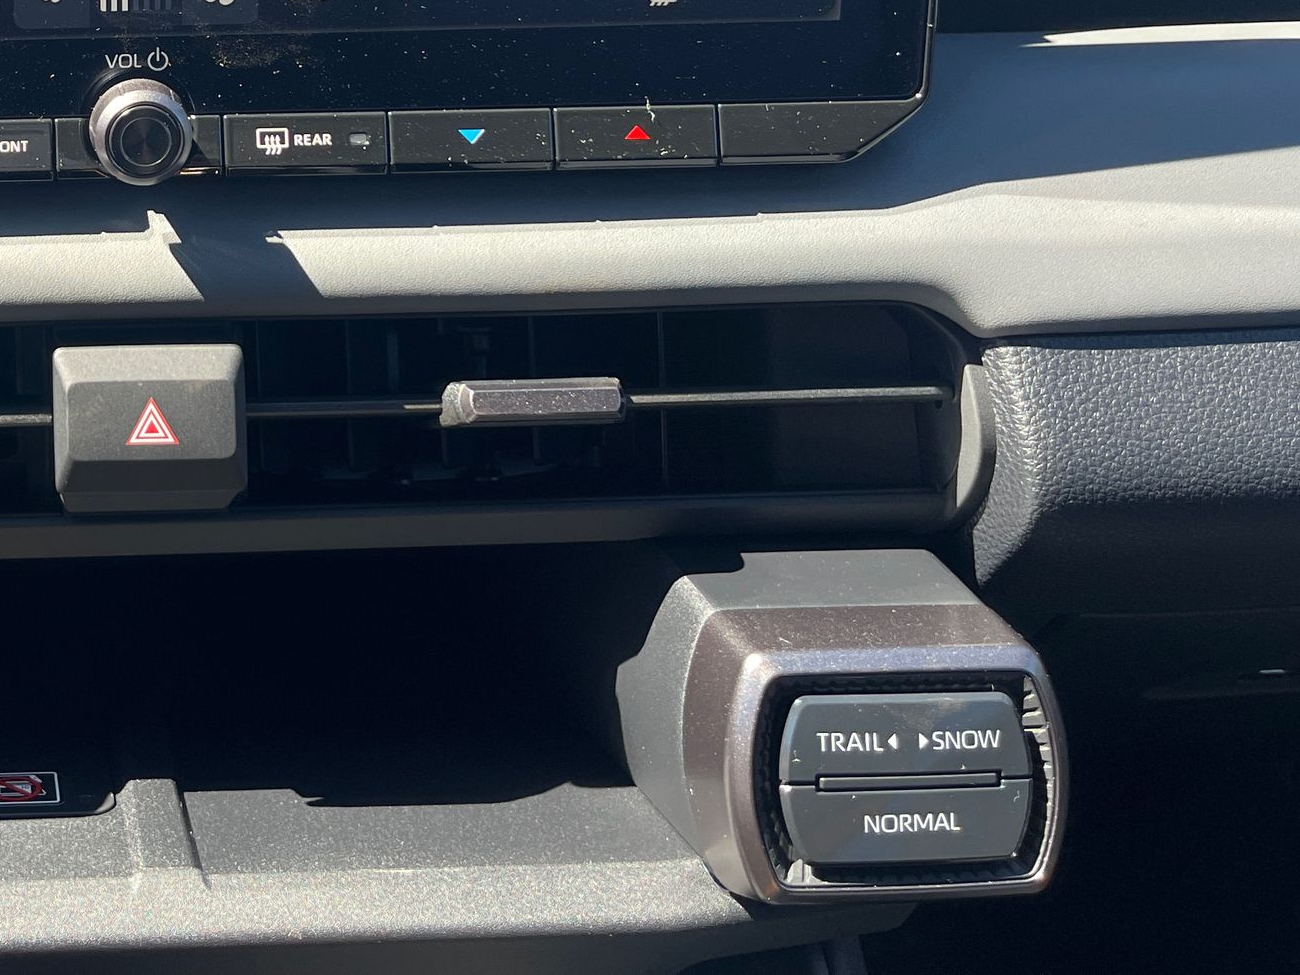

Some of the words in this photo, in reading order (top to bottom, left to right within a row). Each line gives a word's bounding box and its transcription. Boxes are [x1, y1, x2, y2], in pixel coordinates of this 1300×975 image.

[104, 53, 142, 69] VOL
[293, 132, 333, 147] REAR
[816, 732, 884, 753] TRAIL
[932, 729, 1001, 751] SNOW
[863, 812, 961, 834] NORMAL
